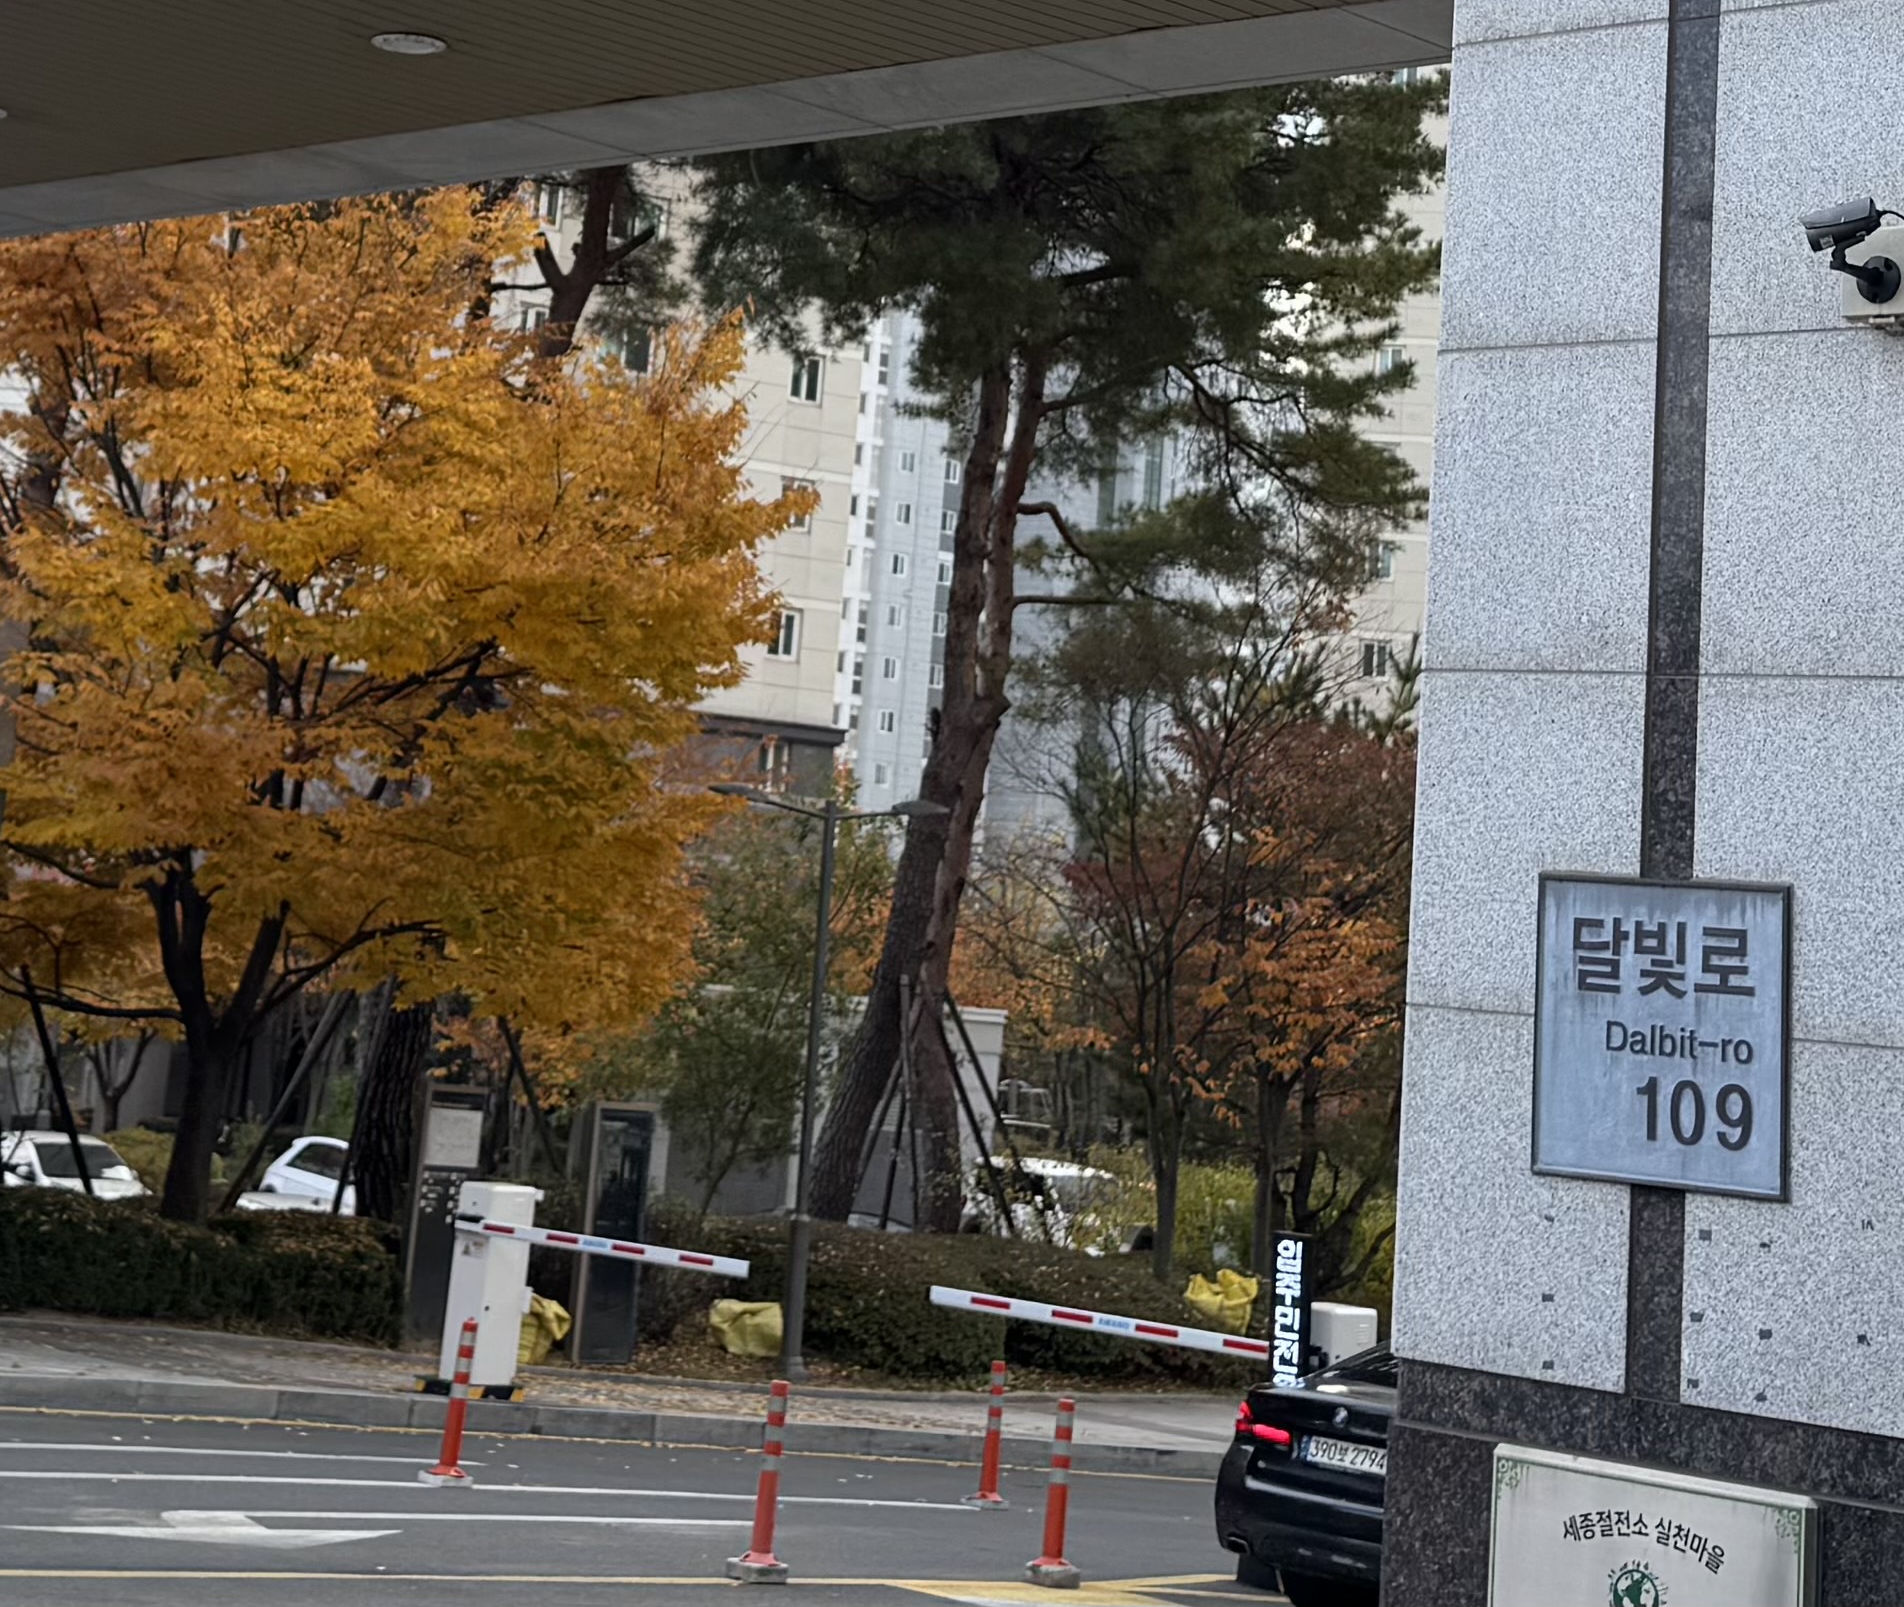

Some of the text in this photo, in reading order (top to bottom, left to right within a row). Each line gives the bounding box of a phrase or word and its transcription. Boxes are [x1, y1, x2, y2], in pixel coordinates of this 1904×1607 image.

[1571, 914, 1757, 1000] 달빛로
[1605, 1019, 1754, 1066] Dalbit-ro
[1635, 1075, 1754, 1152] 109
[1561, 1508, 1727, 1575] 세종절전소 실천마을
